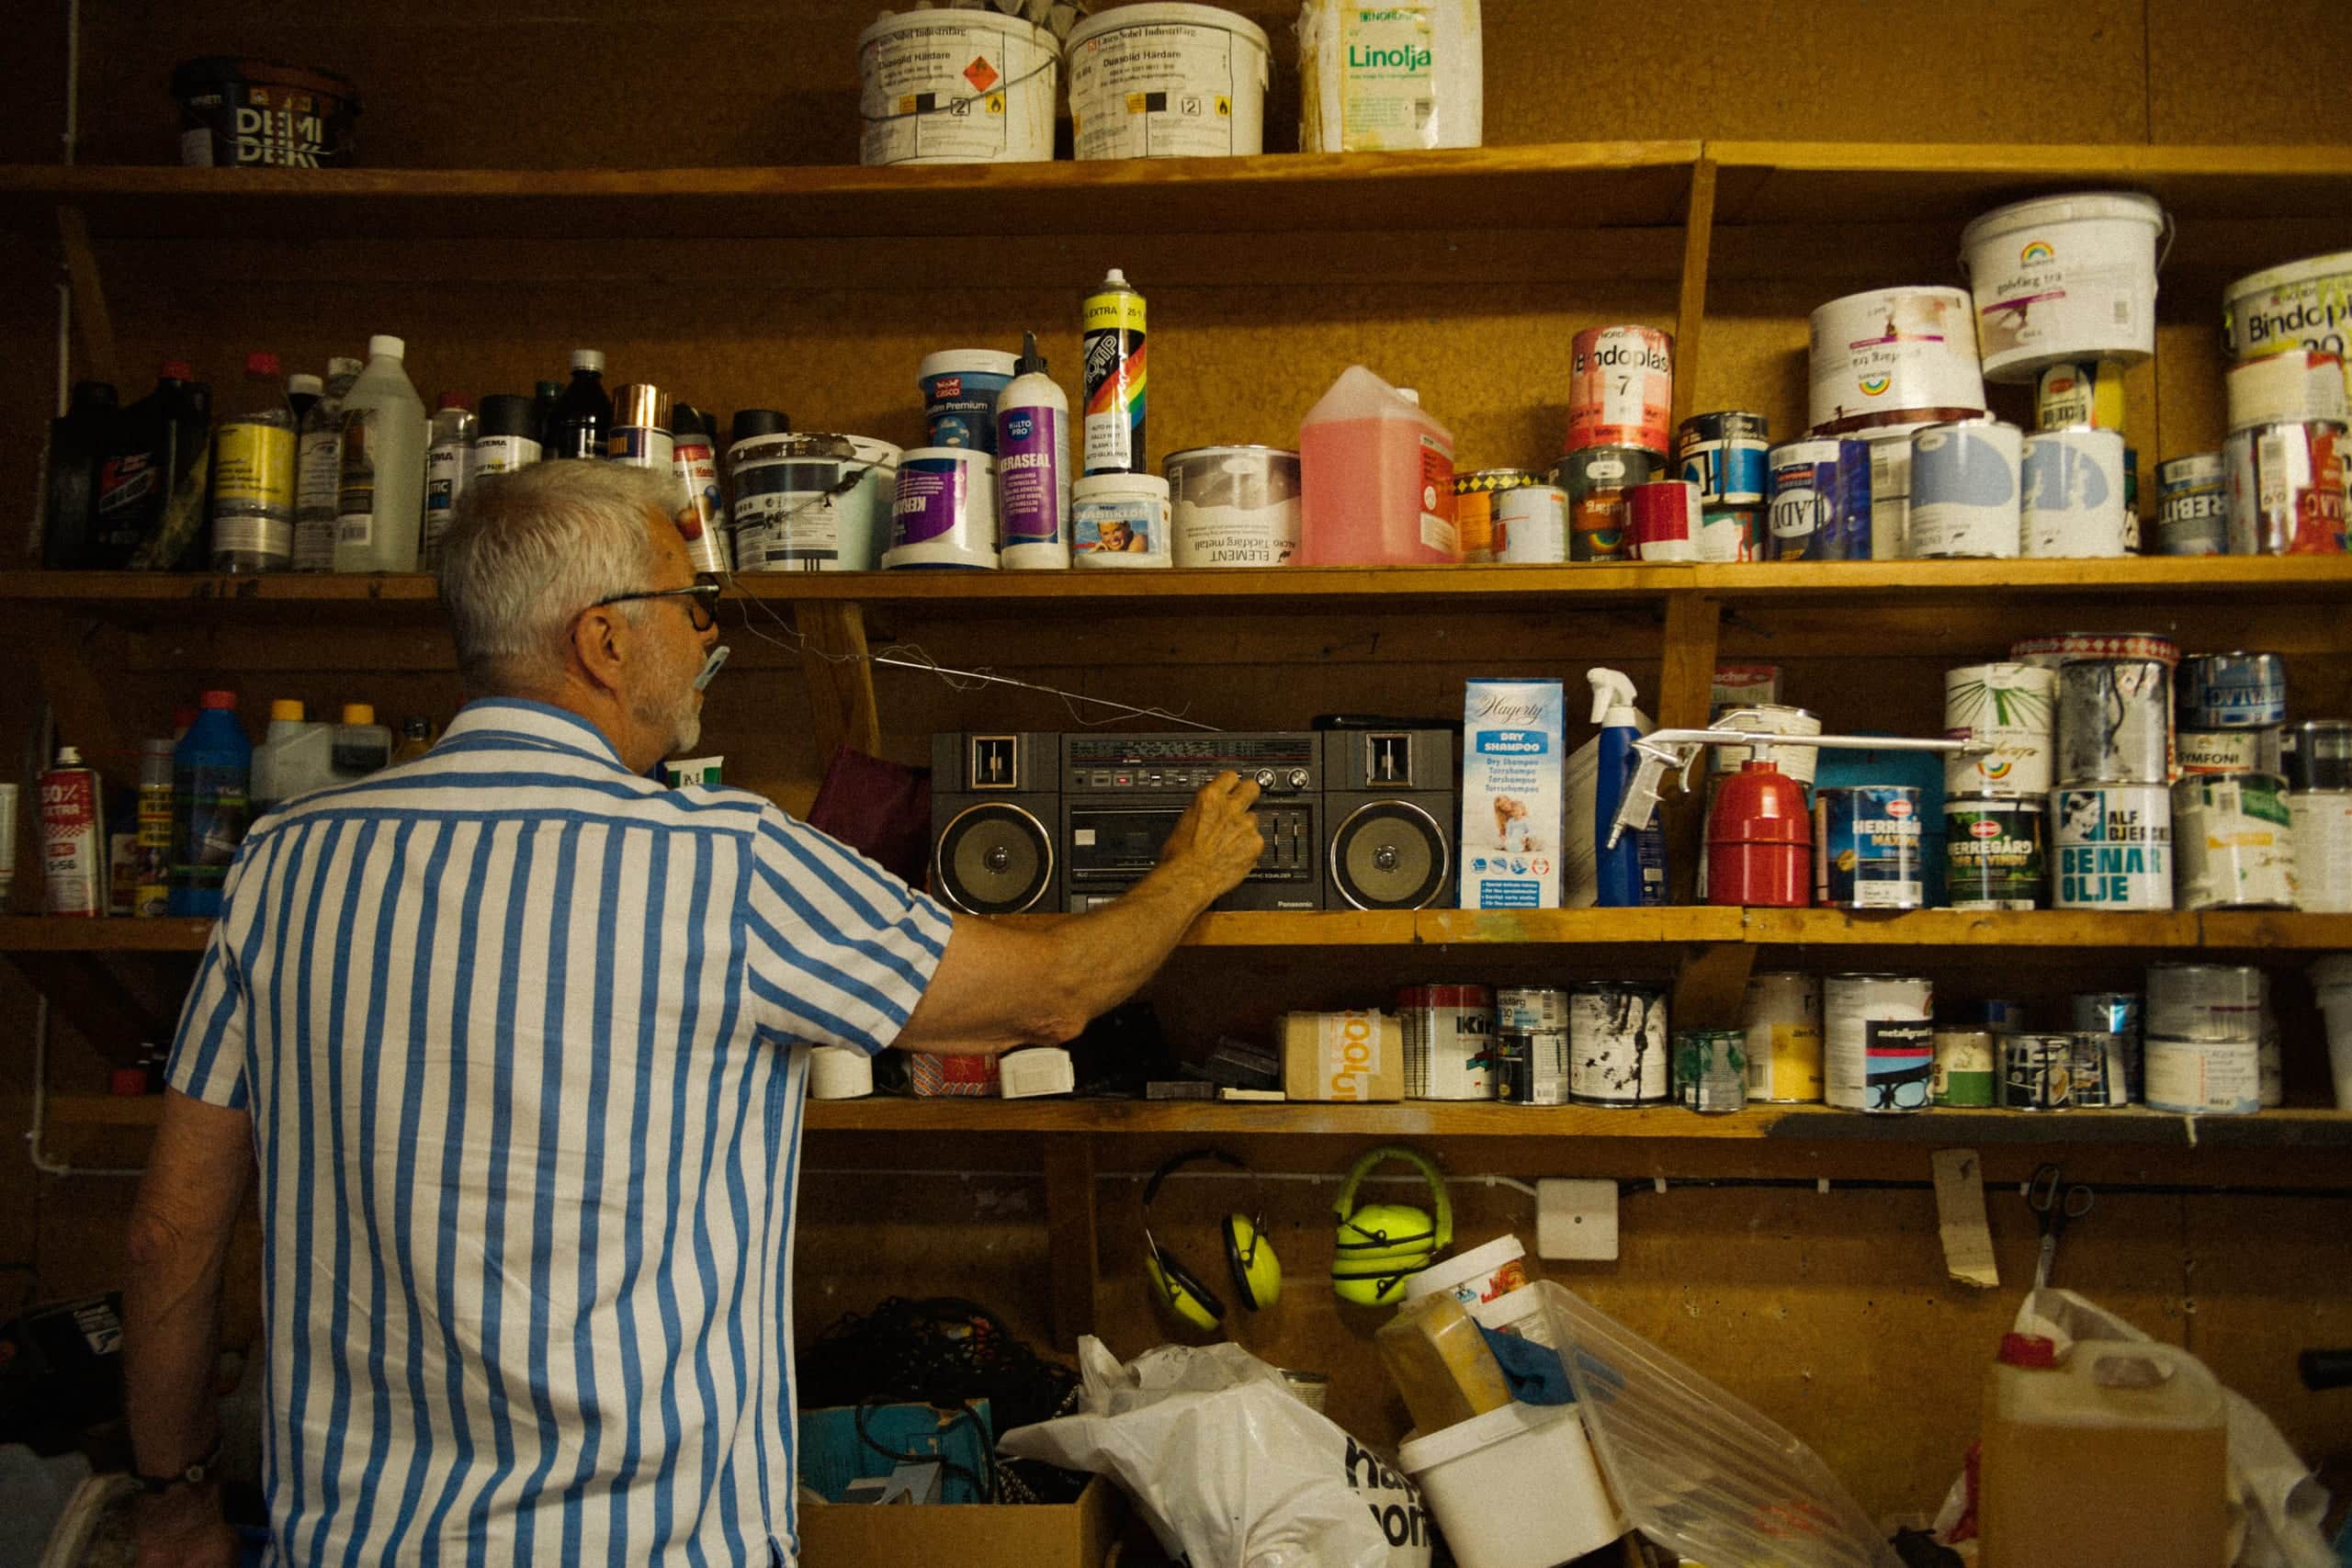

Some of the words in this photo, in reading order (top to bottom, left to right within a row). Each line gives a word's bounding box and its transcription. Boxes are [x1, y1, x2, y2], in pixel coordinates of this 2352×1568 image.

[1350, 44, 1431, 71] Linolja
[956, 100, 966, 114] 2
[1186, 100, 1195, 113] 2
[1089, 307, 1117, 318] EXTRA
[1087, 333, 1118, 384] OTIP
[1617, 375, 1632, 397] 7
[946, 400, 988, 412] Premium
[1012, 428, 1028, 436] PRO
[1000, 453, 1051, 469] KERASEAL
[1210, 549, 1270, 562] ELEMENT
[1479, 695, 1543, 725] Hagerty
[1498, 732, 1525, 741] DRY
[1484, 742, 1541, 752] SHAMPOO
[2178, 753, 2240, 766] SYMFONI
[2109, 810, 2138, 825] ALF
[2063, 875, 2129, 902] OLJE
[1278, 900, 1313, 908] Panasonic
